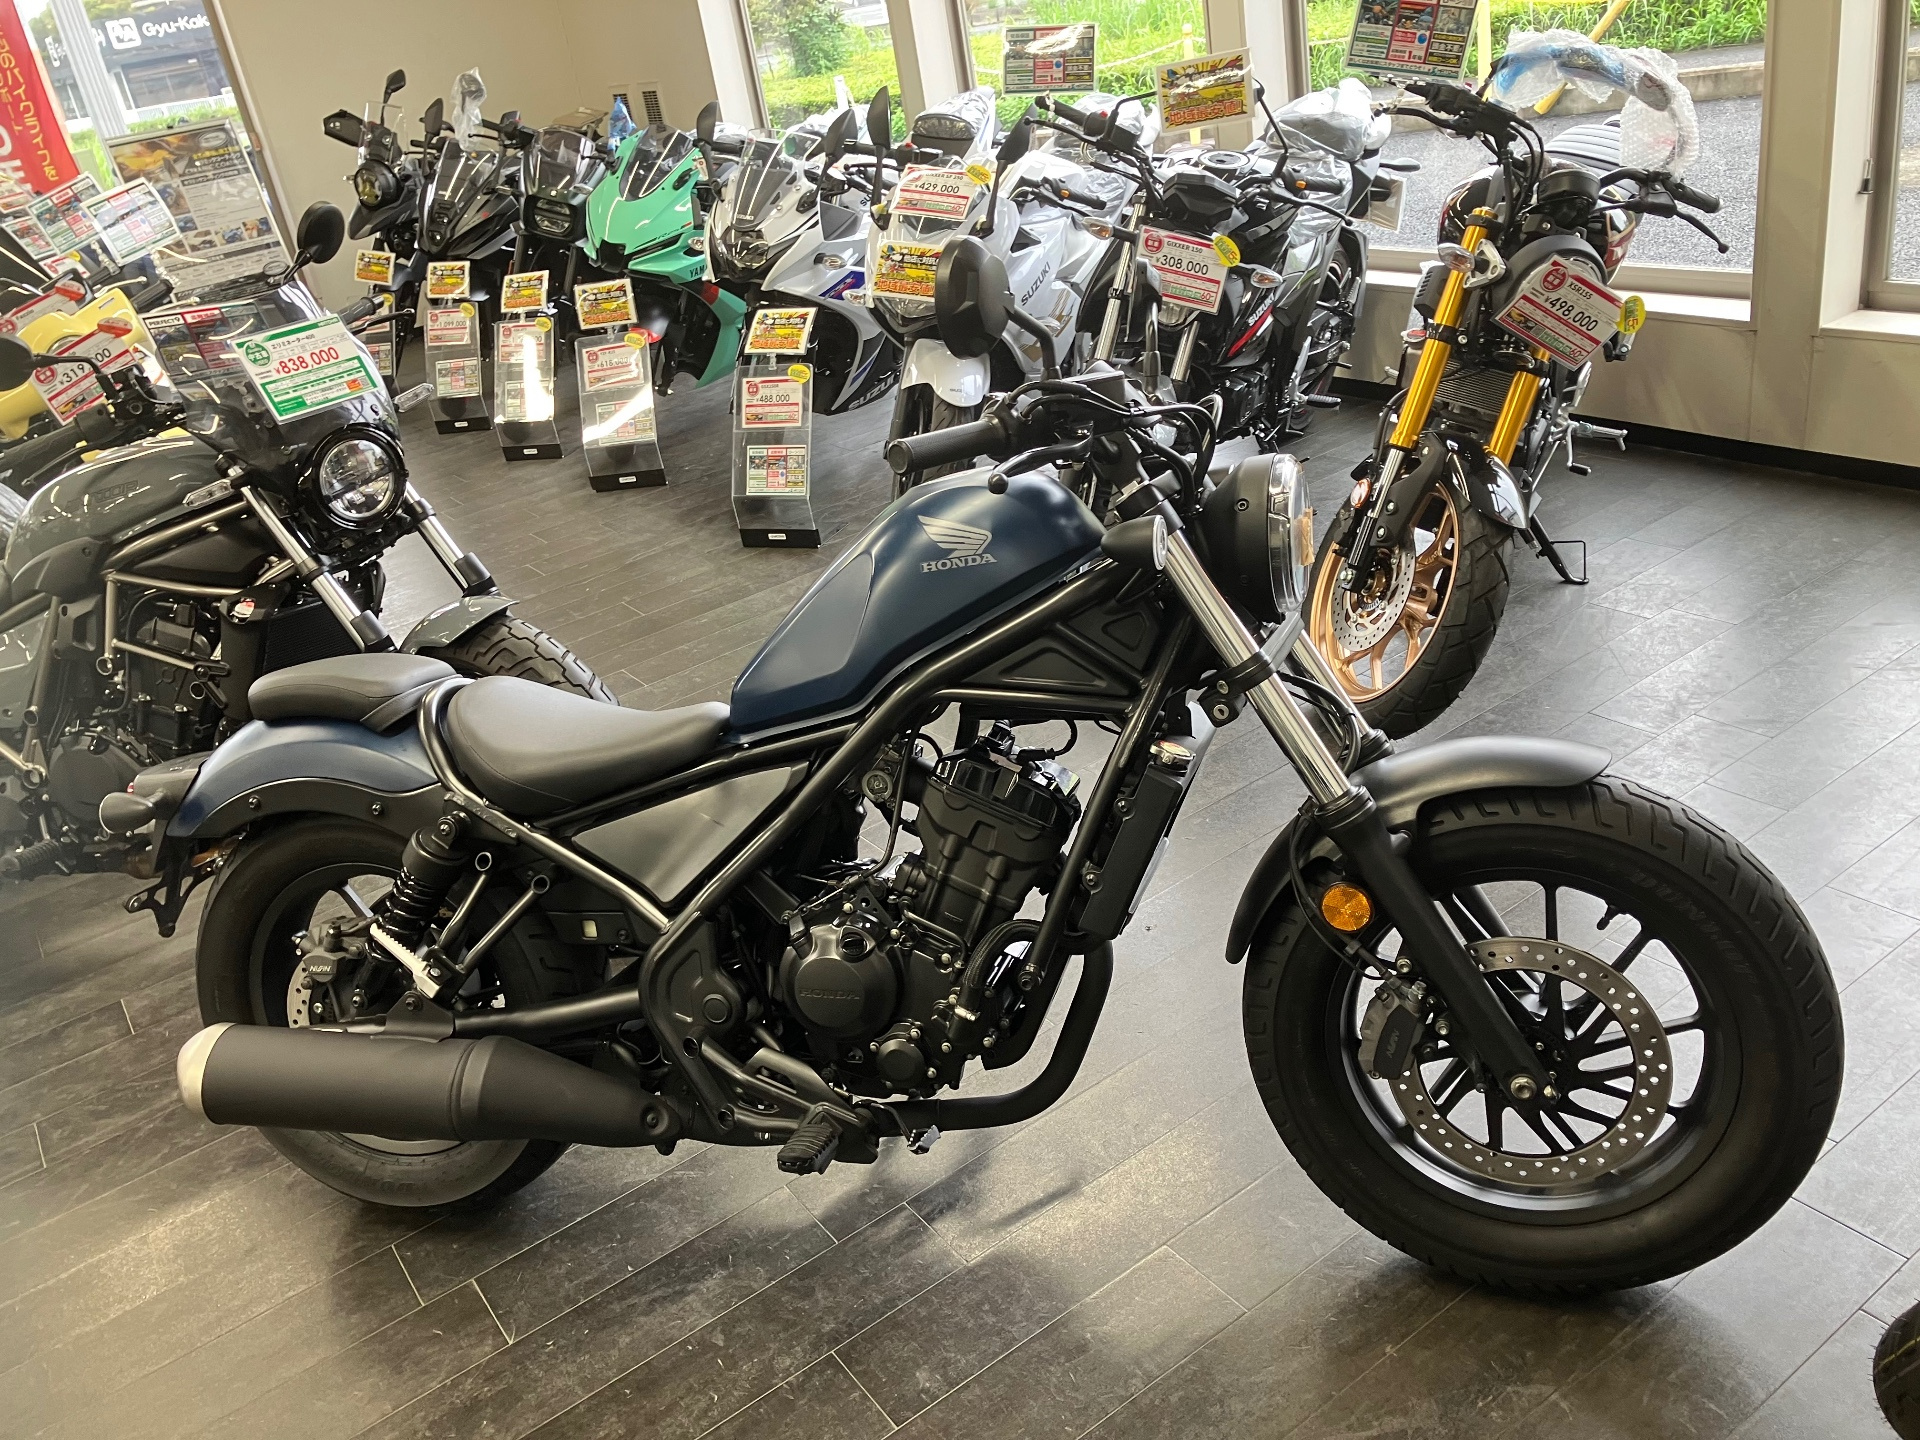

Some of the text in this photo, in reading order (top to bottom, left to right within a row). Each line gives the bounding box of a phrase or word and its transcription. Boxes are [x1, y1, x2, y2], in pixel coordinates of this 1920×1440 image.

[914, 182, 960, 194] ¥429,000
[1166, 240, 1190, 251] GIXXER
[1155, 254, 1209, 275] ¥308,000
[1021, 261, 1051, 307] SUZUKI
[1567, 281, 1594, 300] XSR155
[1248, 292, 1275, 327] SUZUKI
[1545, 296, 1599, 332] ¥498,000
[60, 347, 112, 386] ¥319,00
[274, 346, 340, 375] ¥838,000
[756, 394, 791, 403] ¥488,000
[921, 553, 998, 573] HONDA
[800, 988, 860, 1000] HONDA
